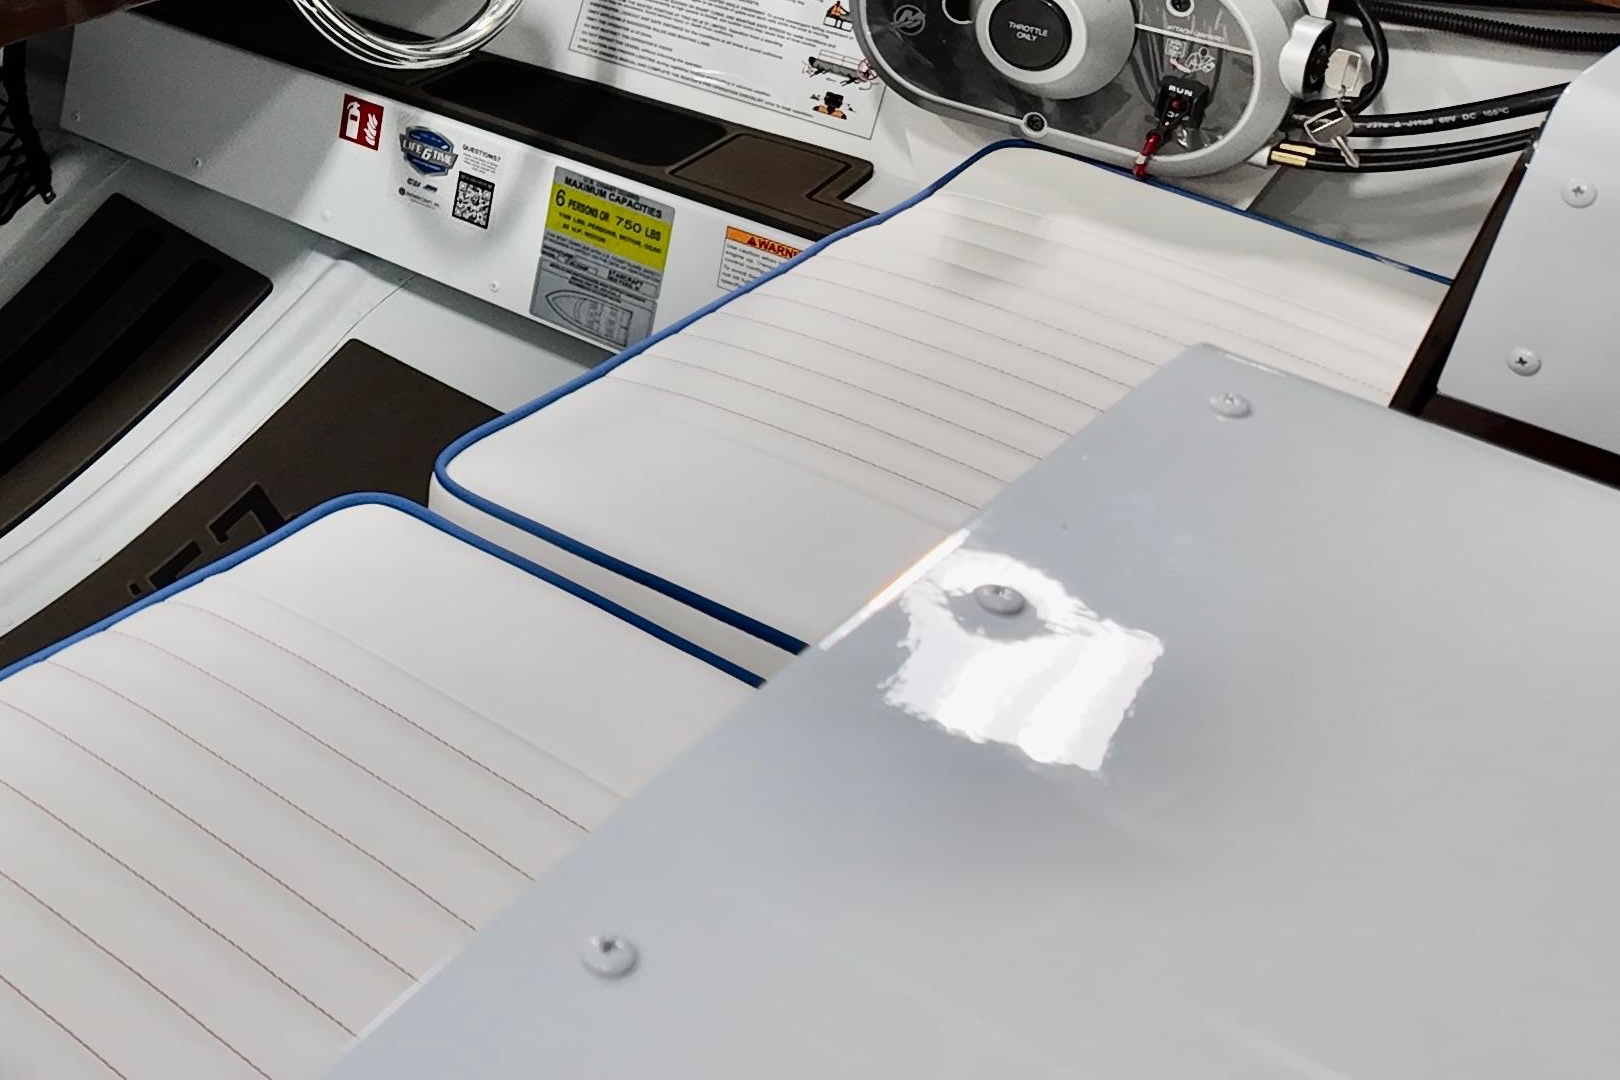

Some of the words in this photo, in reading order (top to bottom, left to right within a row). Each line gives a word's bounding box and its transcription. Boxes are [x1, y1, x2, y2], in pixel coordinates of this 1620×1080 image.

[1009, 21, 1049, 38] THROTTLE
[1016, 31, 1038, 42] ONLY
[1168, 84, 1194, 98] RUN
[1461, 111, 1477, 121] DC
[402, 139, 422, 154] LIFE
[421, 148, 433, 161] 6
[564, 176, 607, 199] MAXIMUM
[609, 191, 663, 219] CAPACITIES
[555, 189, 566, 207] 6
[567, 198, 599, 219] PERSONS
[599, 210, 610, 222] OR
[615, 215, 642, 234] 750
[645, 227, 662, 242] LBS
